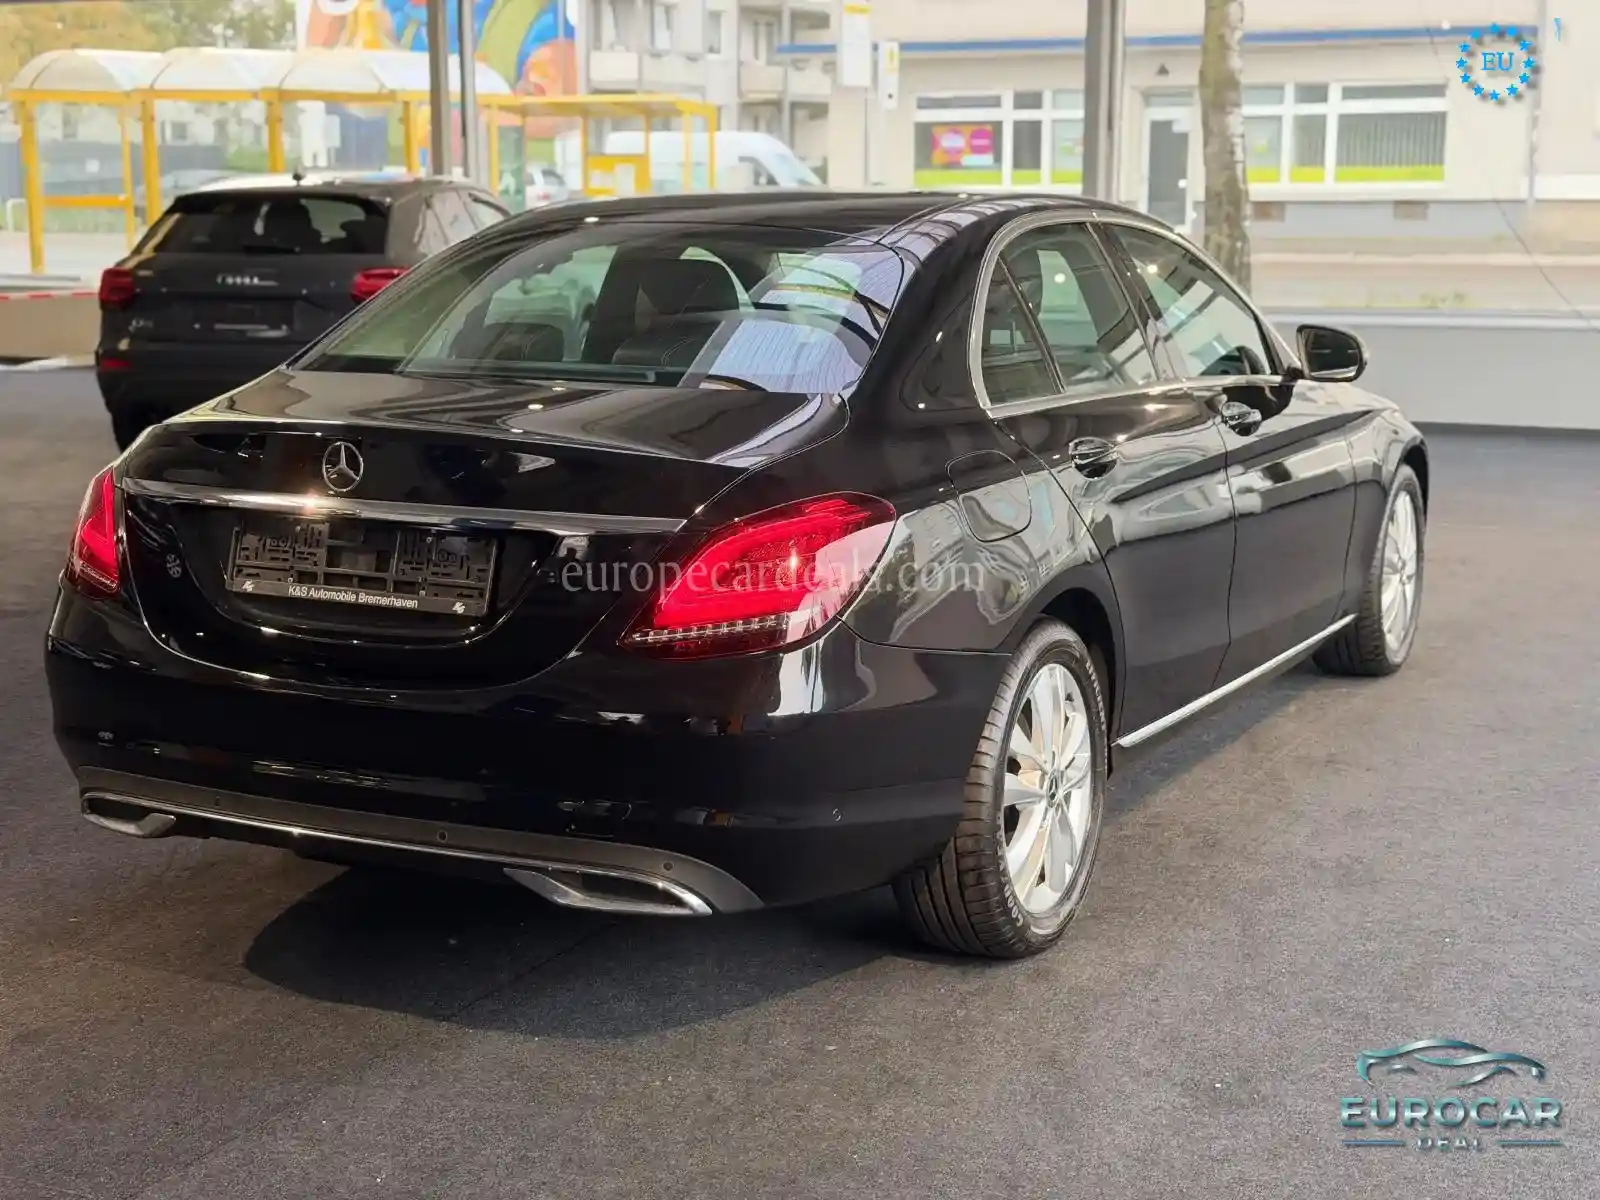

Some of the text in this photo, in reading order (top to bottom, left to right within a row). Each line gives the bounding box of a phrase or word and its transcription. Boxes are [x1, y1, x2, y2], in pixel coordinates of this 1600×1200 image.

[288, 585, 419, 609] K&S Automobile Bremerhaven
